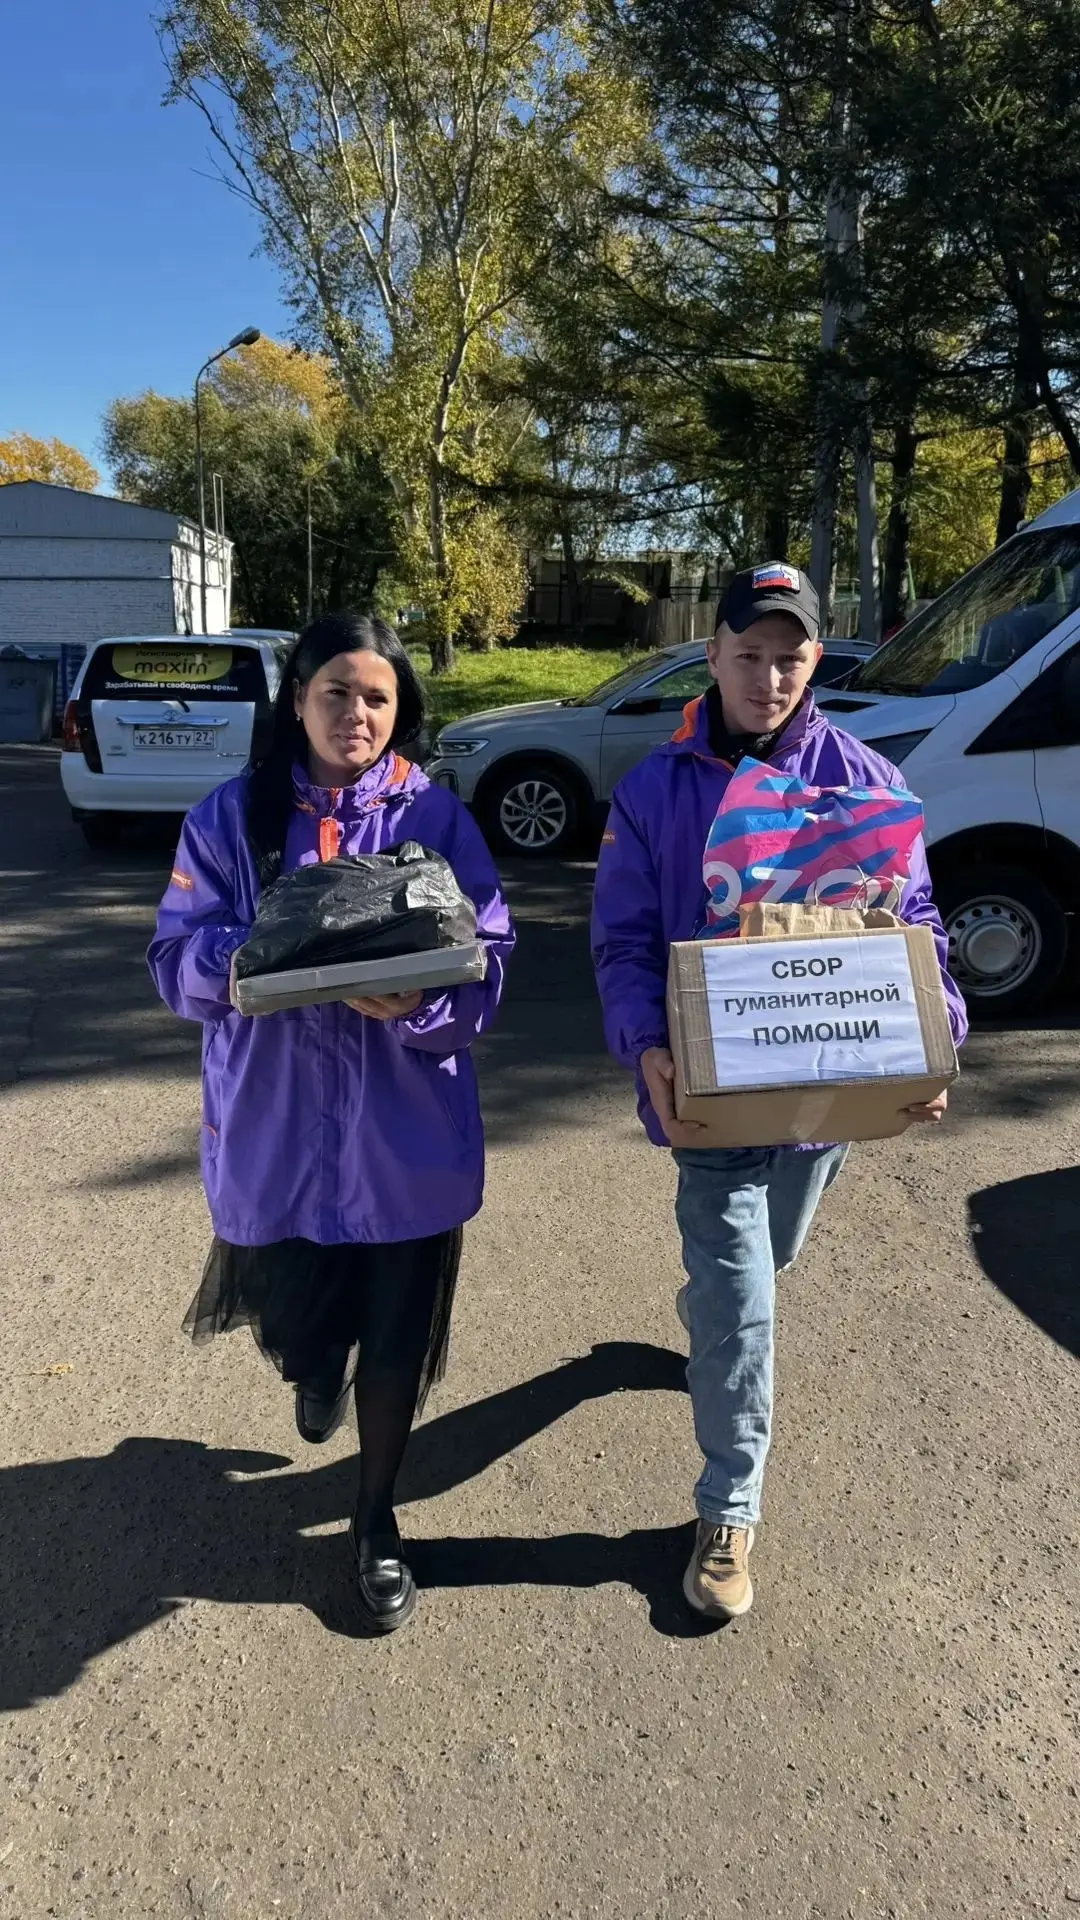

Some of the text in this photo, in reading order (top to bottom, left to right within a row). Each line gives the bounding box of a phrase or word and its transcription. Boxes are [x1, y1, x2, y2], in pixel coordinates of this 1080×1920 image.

[134, 659, 207, 675] maxim
[105, 681, 158, 689] Зарабатывай
[166, 682, 211, 690] свободное
[771, 957, 843, 979] СБОР
[724, 983, 901, 1016] гуманитарной
[753, 1019, 881, 1047] ПОМОЩИ
